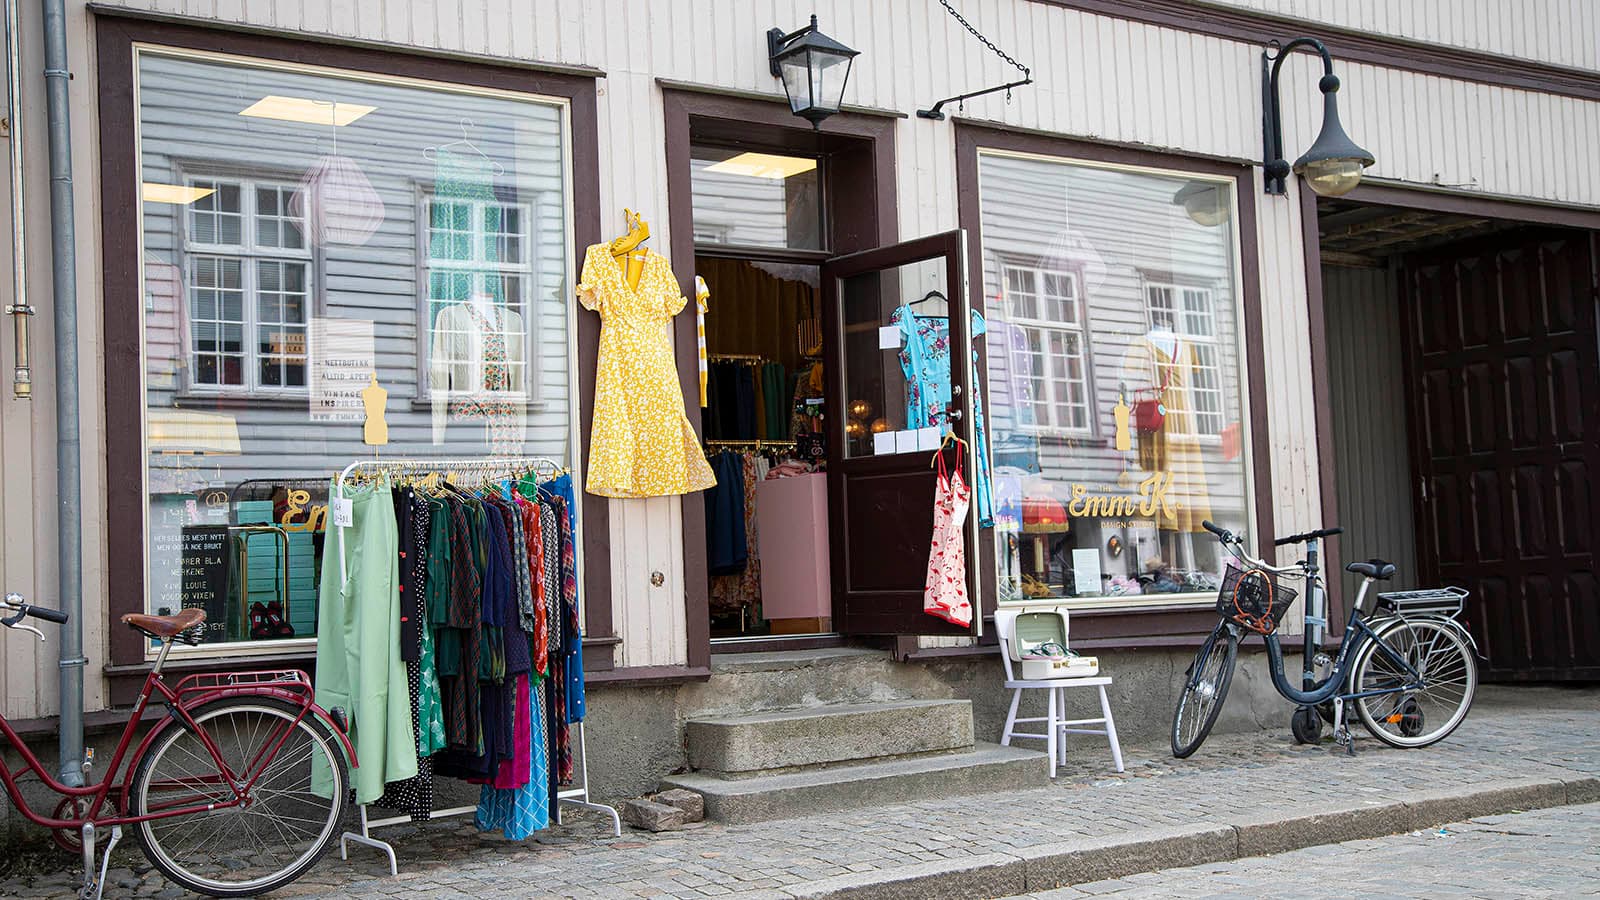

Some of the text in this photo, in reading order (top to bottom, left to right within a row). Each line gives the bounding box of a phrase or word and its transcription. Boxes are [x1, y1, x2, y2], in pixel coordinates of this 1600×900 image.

[1069, 482, 1136, 517] Emm
[209, 533, 226, 541] NYTT
[185, 581, 208, 590] LOUIE
[192, 591, 215, 600] VIXEN
